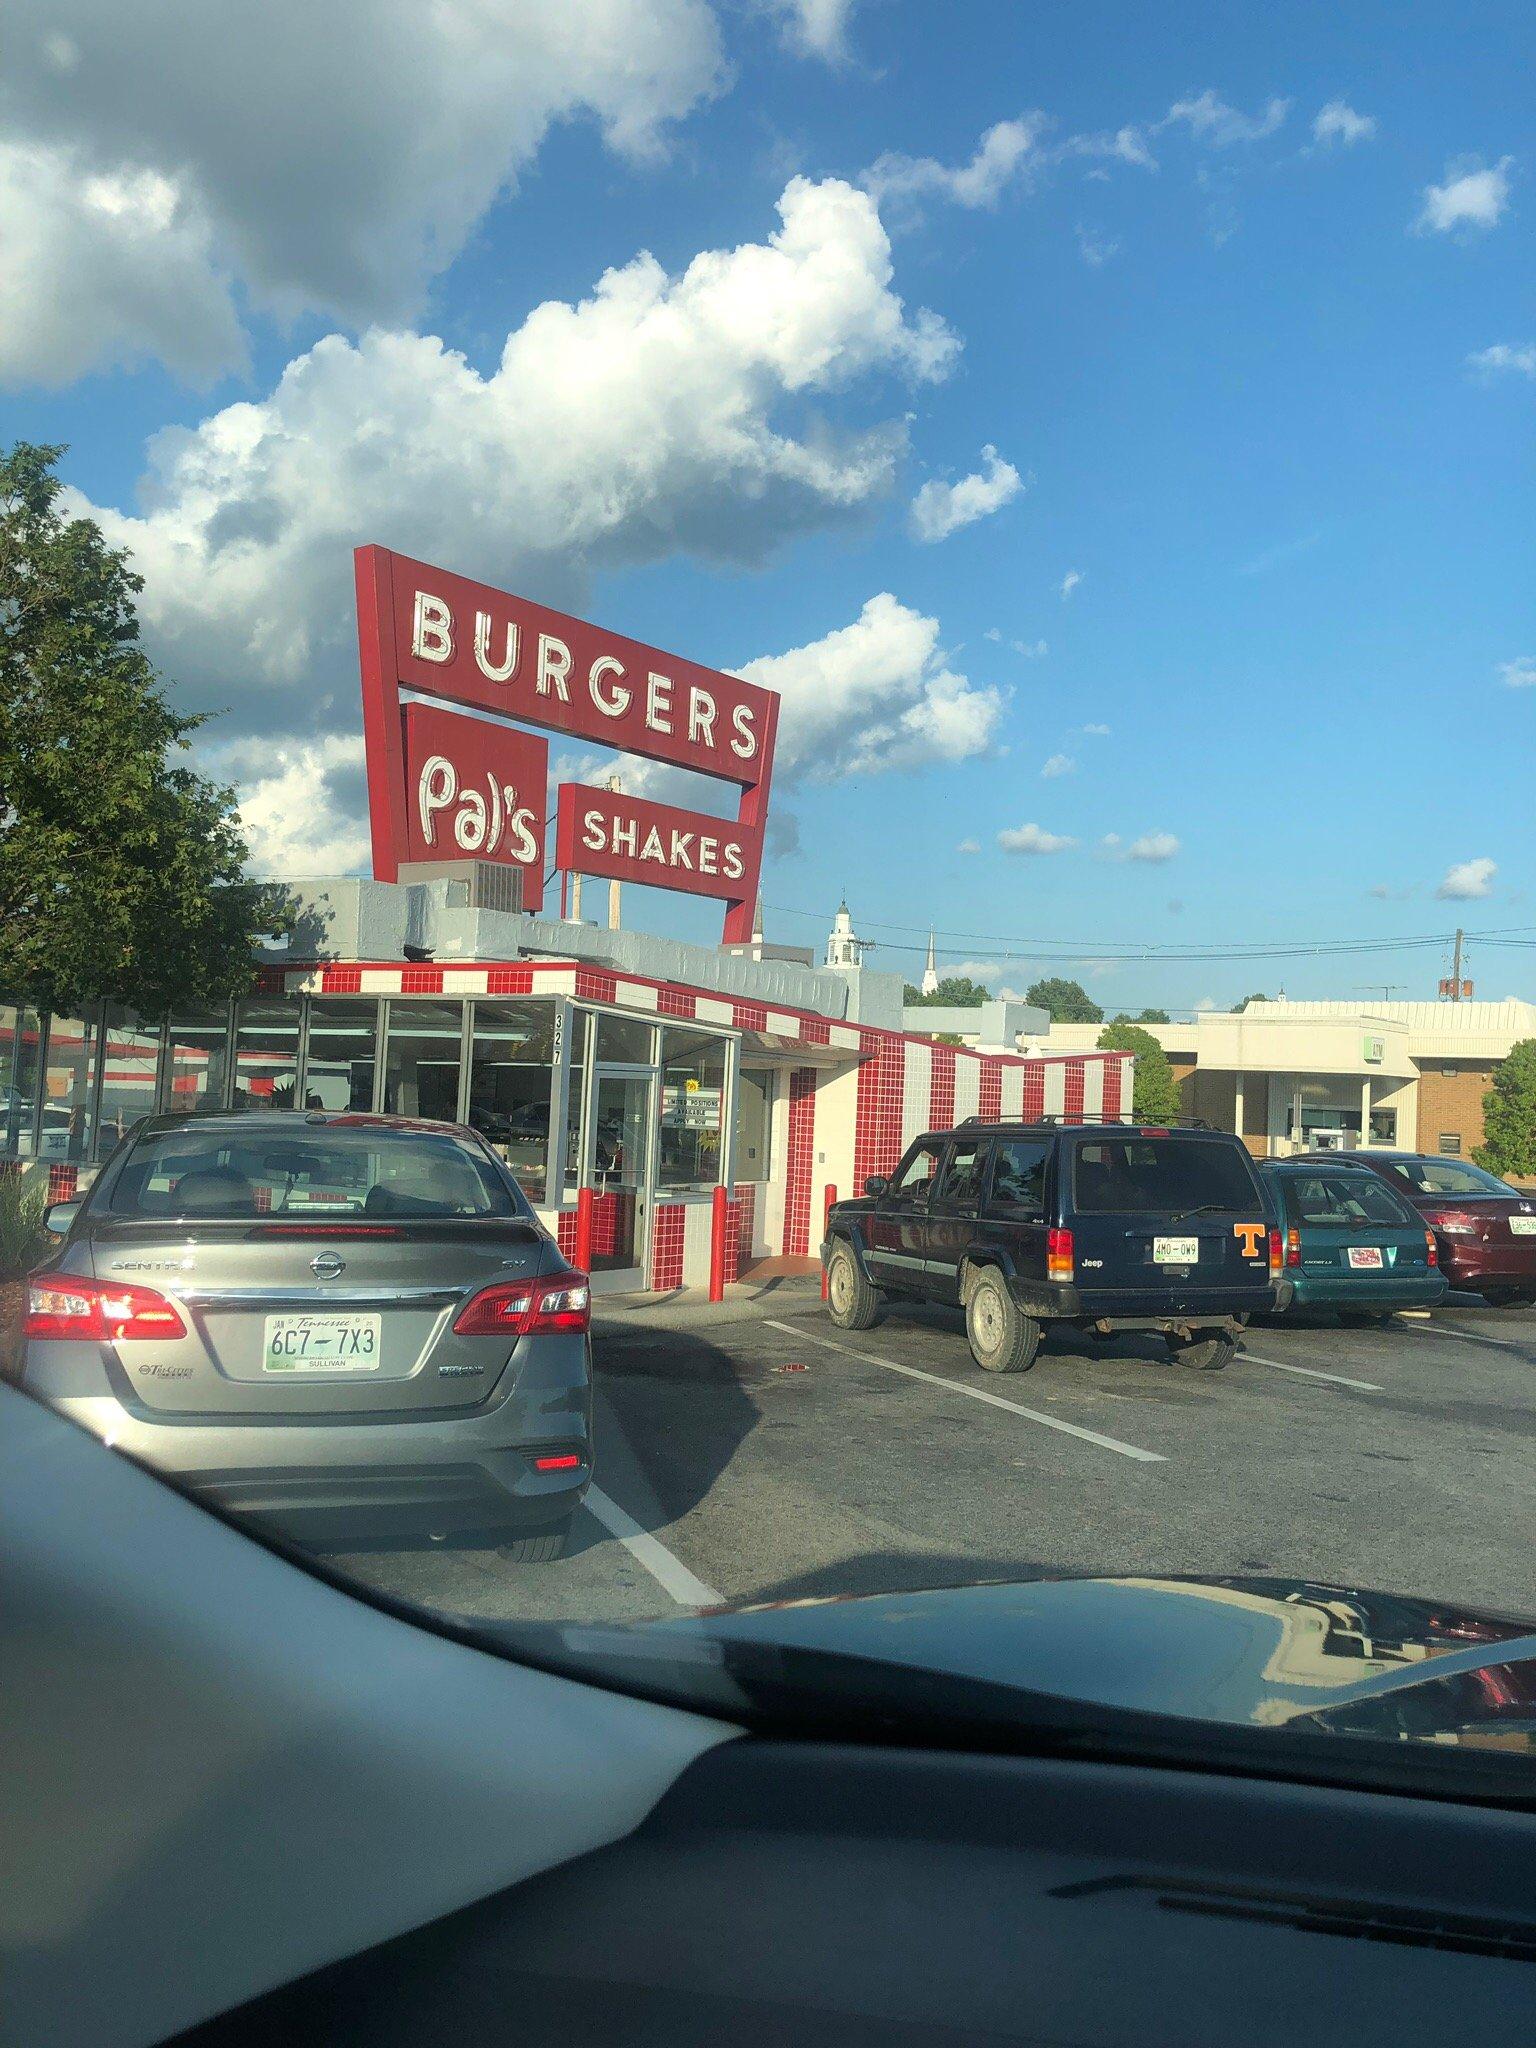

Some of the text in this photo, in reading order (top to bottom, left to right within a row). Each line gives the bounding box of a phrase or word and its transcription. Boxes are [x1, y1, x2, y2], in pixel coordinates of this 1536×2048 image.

[409, 589, 760, 760] BURGERS
[418, 754, 541, 865] Pal's
[581, 810, 747, 880] SHAKES
[1372, 1043, 1383, 1057] ATM
[690, 1099, 718, 1107] POSITIONS
[677, 1108, 705, 1117] AVAILABLE
[694, 1118, 705, 1126] NOW
[1233, 1223, 1266, 1257] T
[1081, 1258, 1103, 1268] Jeep
[296, 1317, 352, 1329] Tennessee
[309, 1359, 347, 1368] SULLIVAN
